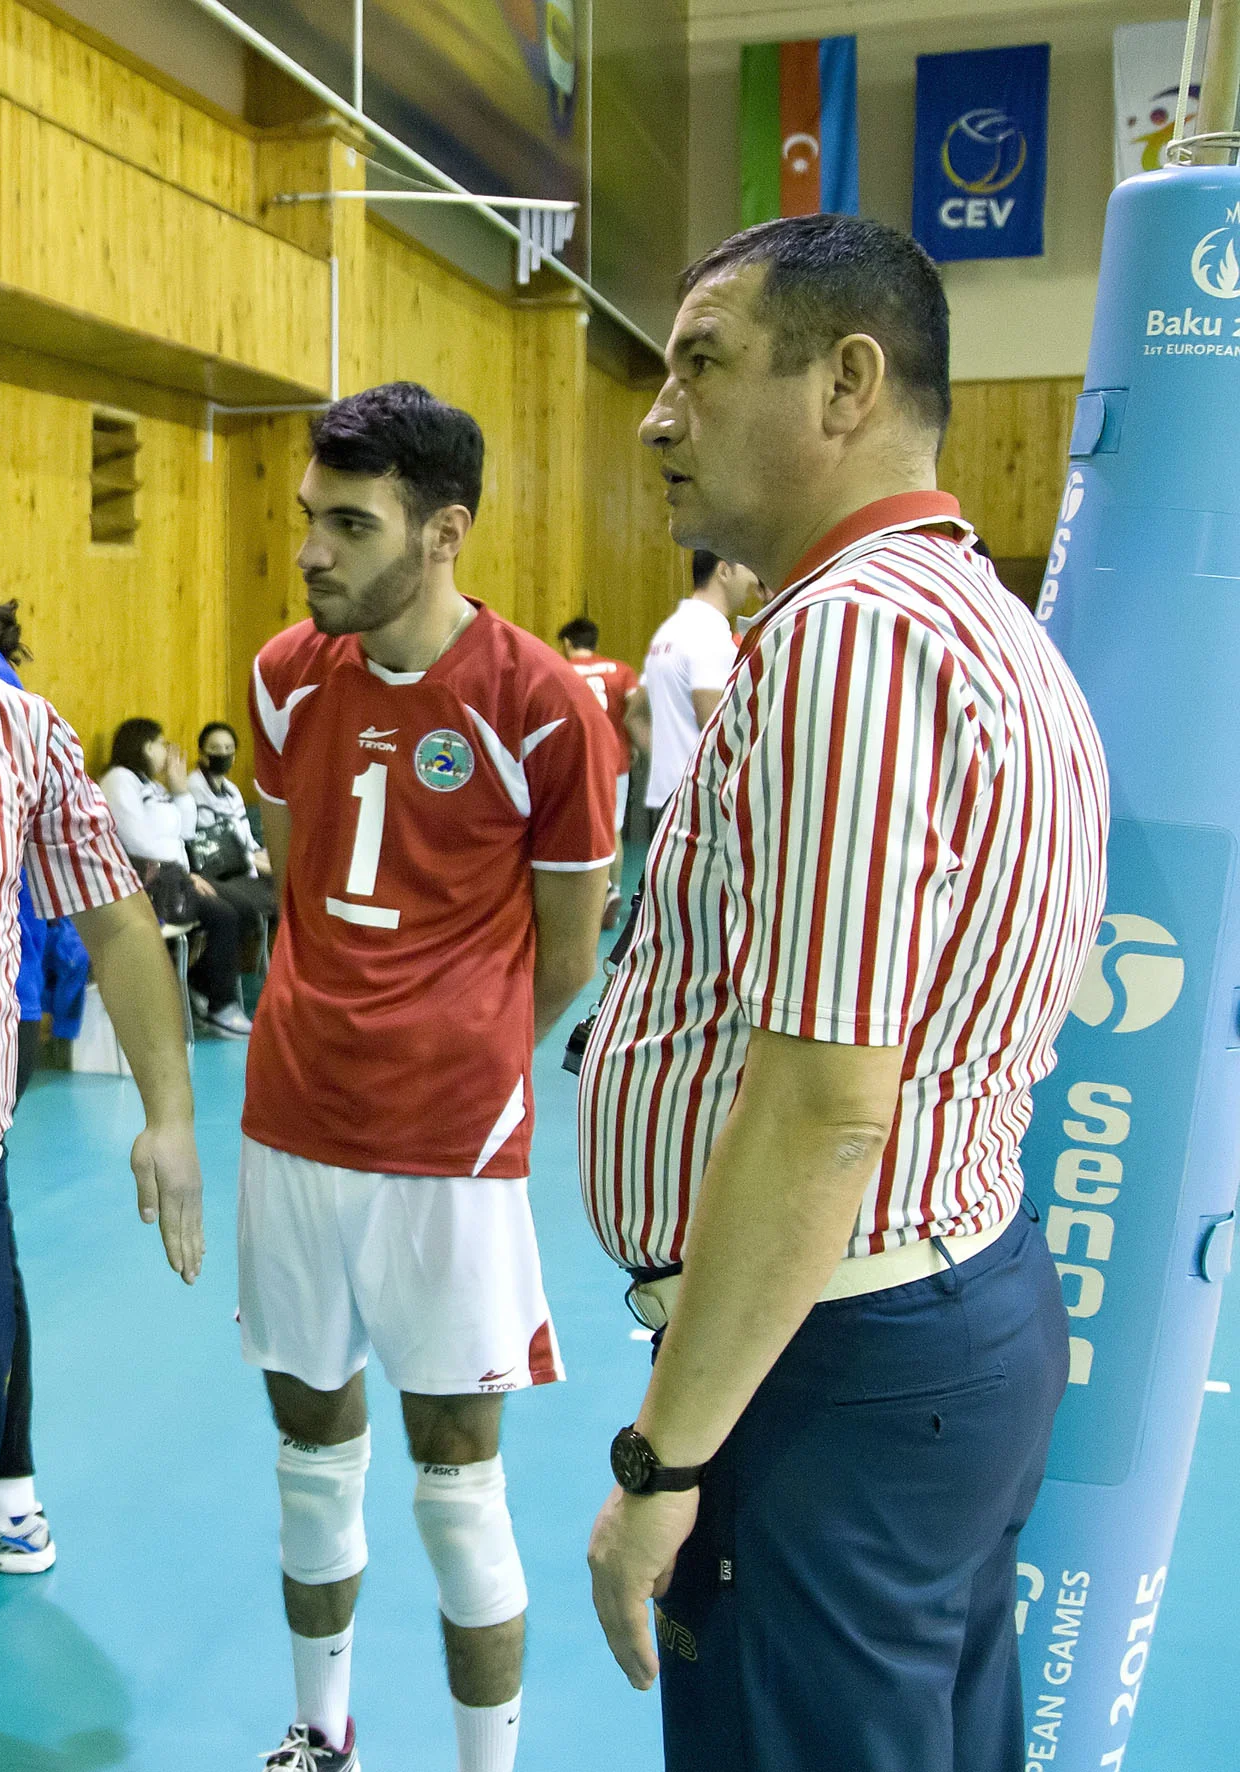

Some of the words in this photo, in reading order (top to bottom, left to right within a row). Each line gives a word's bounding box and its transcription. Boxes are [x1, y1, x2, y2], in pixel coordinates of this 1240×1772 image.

[940, 198, 1015, 228] CEV
[1146, 307, 1222, 336] Baku
[346, 762, 388, 896] 1
[478, 1383, 517, 1392] TRYON
[1043, 1569, 1090, 1685] GAMES
